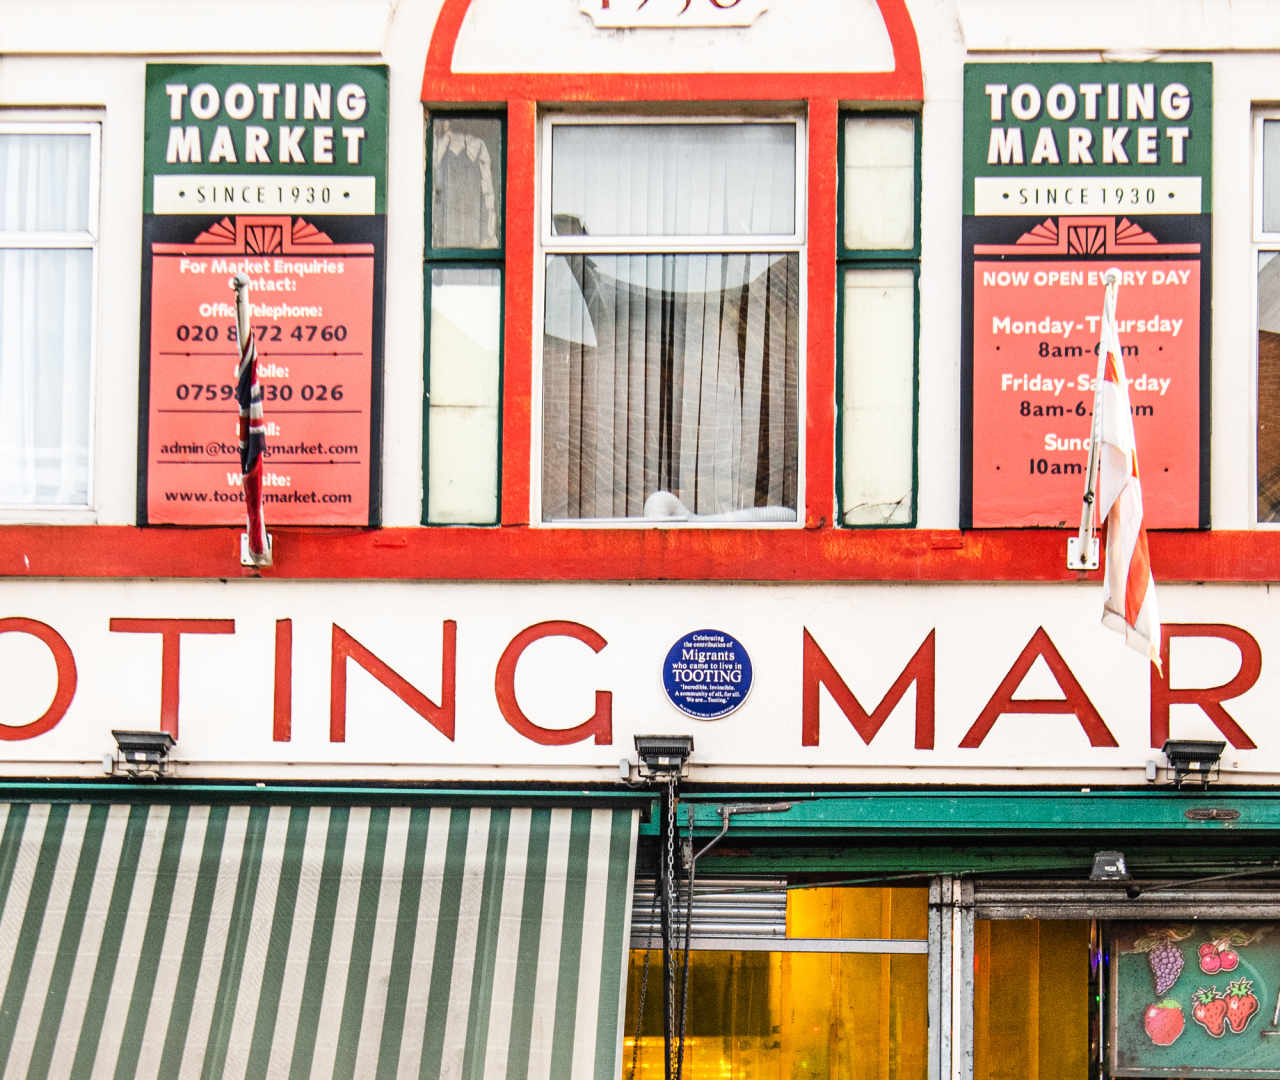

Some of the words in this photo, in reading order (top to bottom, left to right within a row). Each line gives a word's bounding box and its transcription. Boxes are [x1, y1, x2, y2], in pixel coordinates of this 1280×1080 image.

[165, 83, 367, 120] TOOTING
[985, 82, 1192, 121] TOOTING
[166, 125, 365, 164] MARKET
[986, 126, 1190, 165] MARKET
[197, 186, 265, 204] SINCE
[277, 186, 331, 204] 1930
[1019, 188, 1089, 204] SINCE
[1101, 188, 1156, 204] 1930
[180, 259, 208, 274] For
[211, 259, 270, 274] Market
[273, 260, 344, 278] Enquiries
[983, 272, 1029, 286] NOW
[1034, 272, 1085, 286] OPEN
[1152, 270, 1192, 285] DAY
[176, 325, 219, 342] 020
[227, 325, 282, 342] 872
[290, 325, 348, 342] 4760
[301, 384, 344, 401] 026
[682, 649, 735, 662] Migrants
[672, 670, 742, 682] TOOTING
